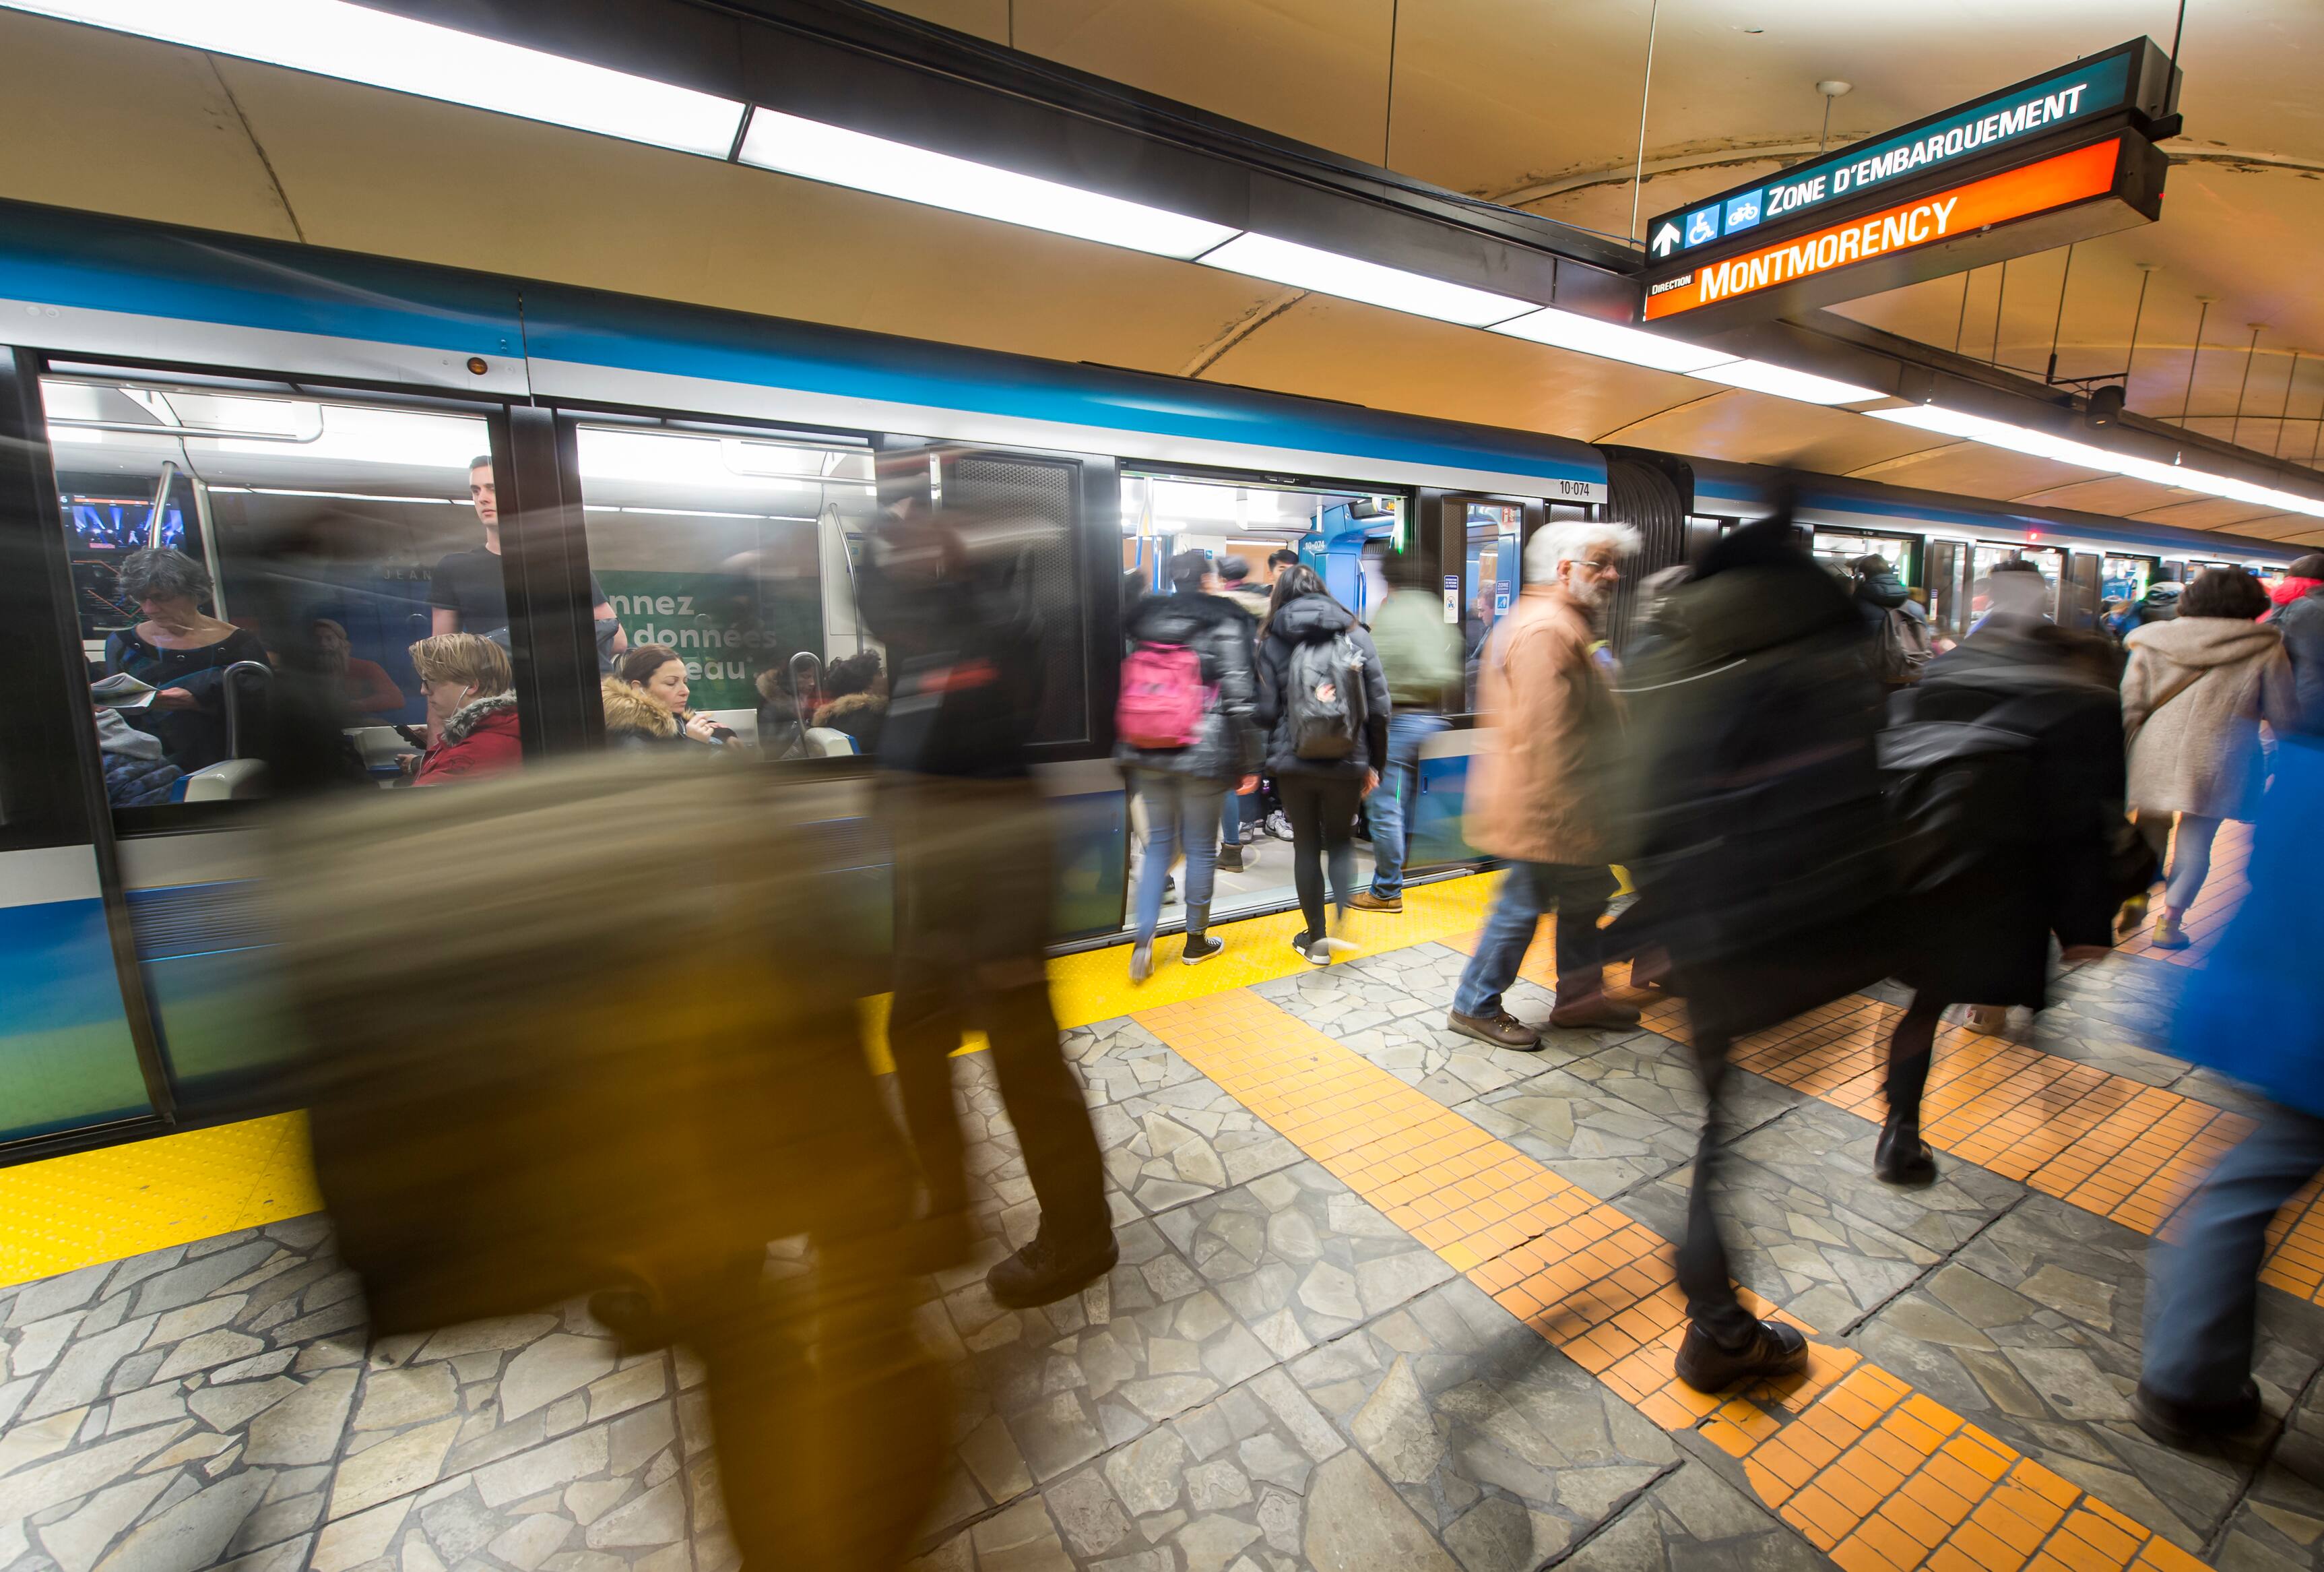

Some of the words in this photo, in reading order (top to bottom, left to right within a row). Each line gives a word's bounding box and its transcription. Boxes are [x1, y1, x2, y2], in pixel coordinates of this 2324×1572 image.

[1766, 176, 1826, 216] ZONE
[1832, 84, 2087, 195] D'EMBARQUEMENT
[1700, 197, 1958, 303] MONTMORENCY
[1652, 275, 1691, 295] DIRECTION
[633, 623, 777, 648] données
